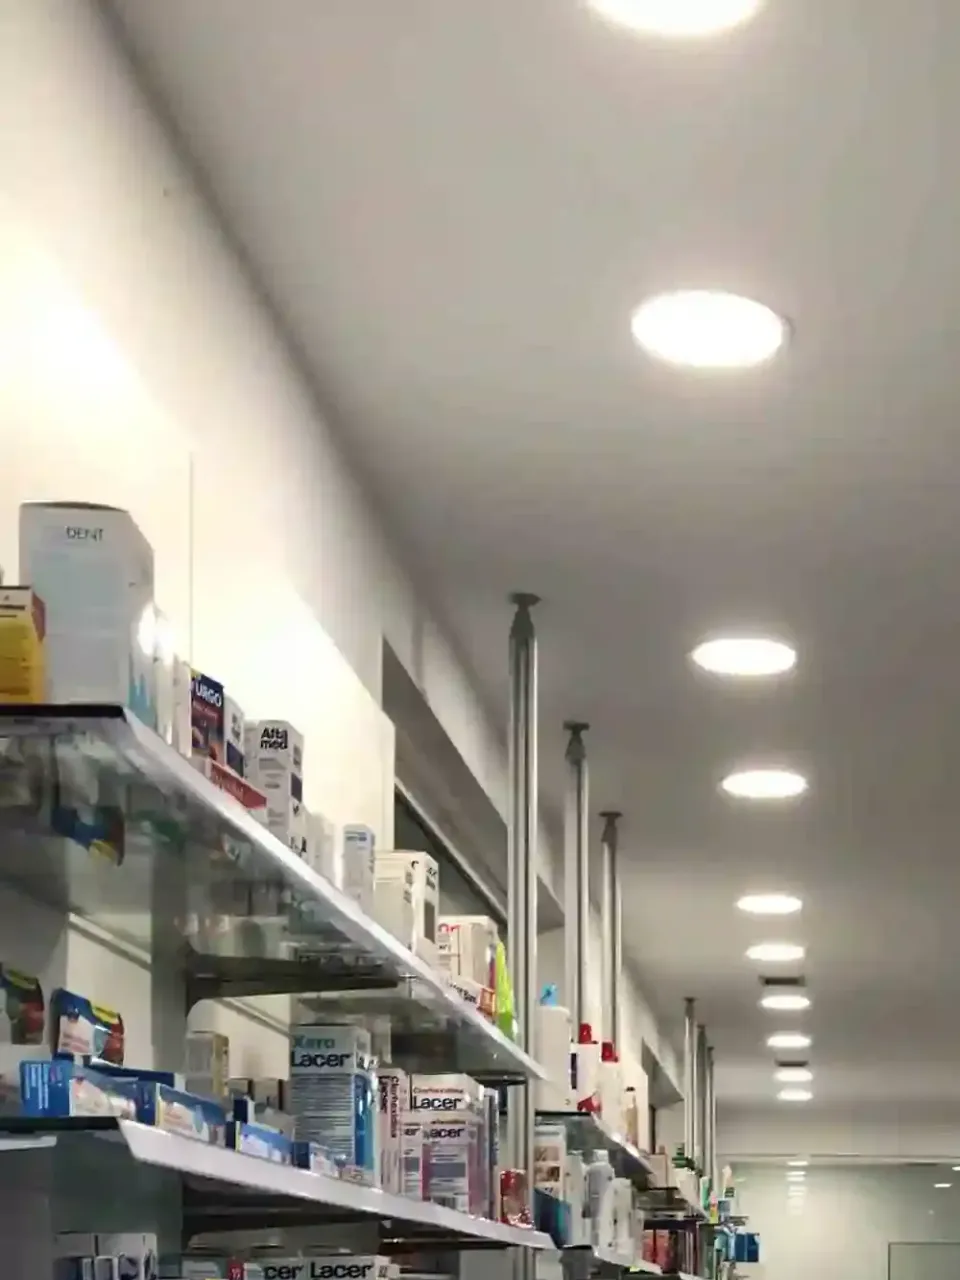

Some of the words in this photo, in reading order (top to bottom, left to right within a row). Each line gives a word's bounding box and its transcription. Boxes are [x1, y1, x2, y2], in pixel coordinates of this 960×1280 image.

[195, 681, 222, 707] URGO
[291, 1052, 351, 1067] Lacer
[413, 1095, 462, 1110] Lacer
[429, 1127, 465, 1138] acer
[264, 1264, 304, 1280] cer
[309, 1261, 375, 1279] Lacer
